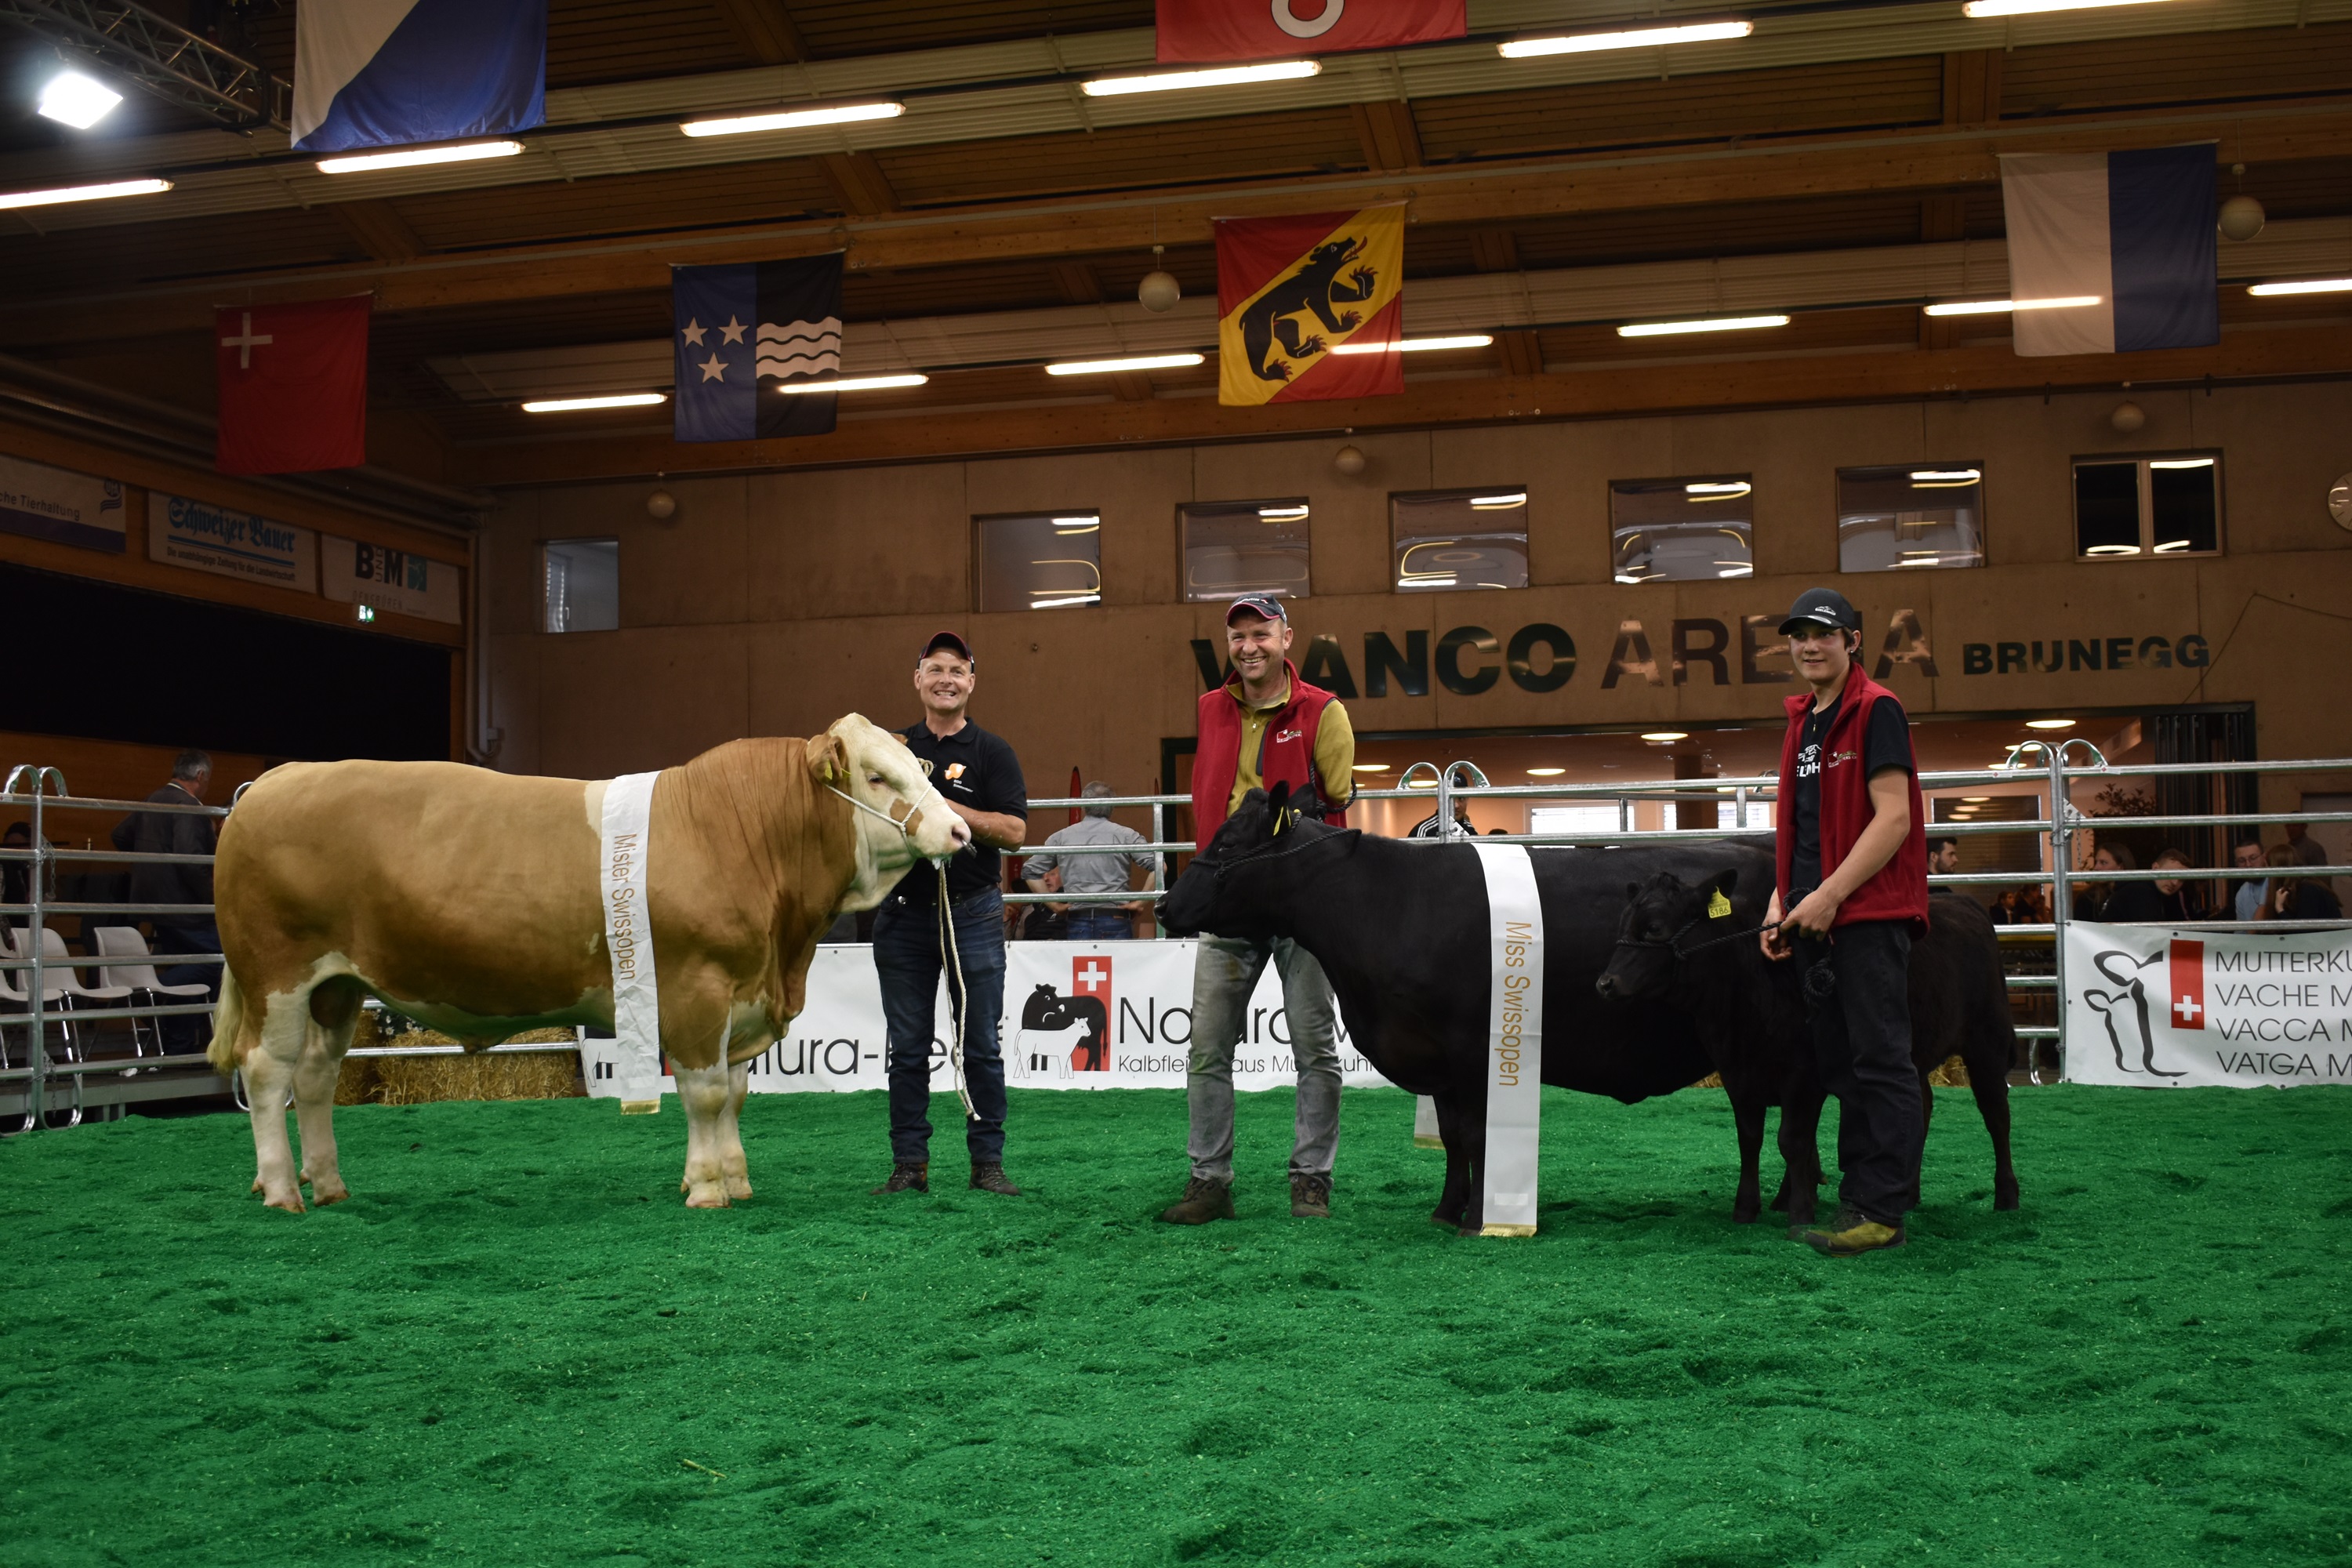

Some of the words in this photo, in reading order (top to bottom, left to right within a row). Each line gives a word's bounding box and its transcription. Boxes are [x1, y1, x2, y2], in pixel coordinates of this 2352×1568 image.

[20, 495, 80, 521] Tierhaltung
[169, 497, 246, 544] Schweizer
[249, 516, 296, 553] Bauer
[167, 546, 176, 557] Die
[178, 550, 216, 566] unabhängige
[217, 556, 238, 572] Zeitung
[246, 563, 255, 573] die
[256, 565, 296, 583] Landwirtschaft
[1190, 623, 1577, 699] VANCO
[1964, 634, 2209, 675] BRUNEGG
[612, 833, 637, 883] Mister
[1710, 907, 1729, 917] 5186
[612, 887, 636, 981] Swissopen
[1505, 921, 1532, 967] Miss
[2215, 983, 2319, 1007] VACHE
[1494, 975, 1531, 1087] Swissopen
[2216, 1018, 2332, 1042] VACCA
[1231, 1058, 1265, 1073] aus
[2216, 1051, 2318, 1076] VATGA
